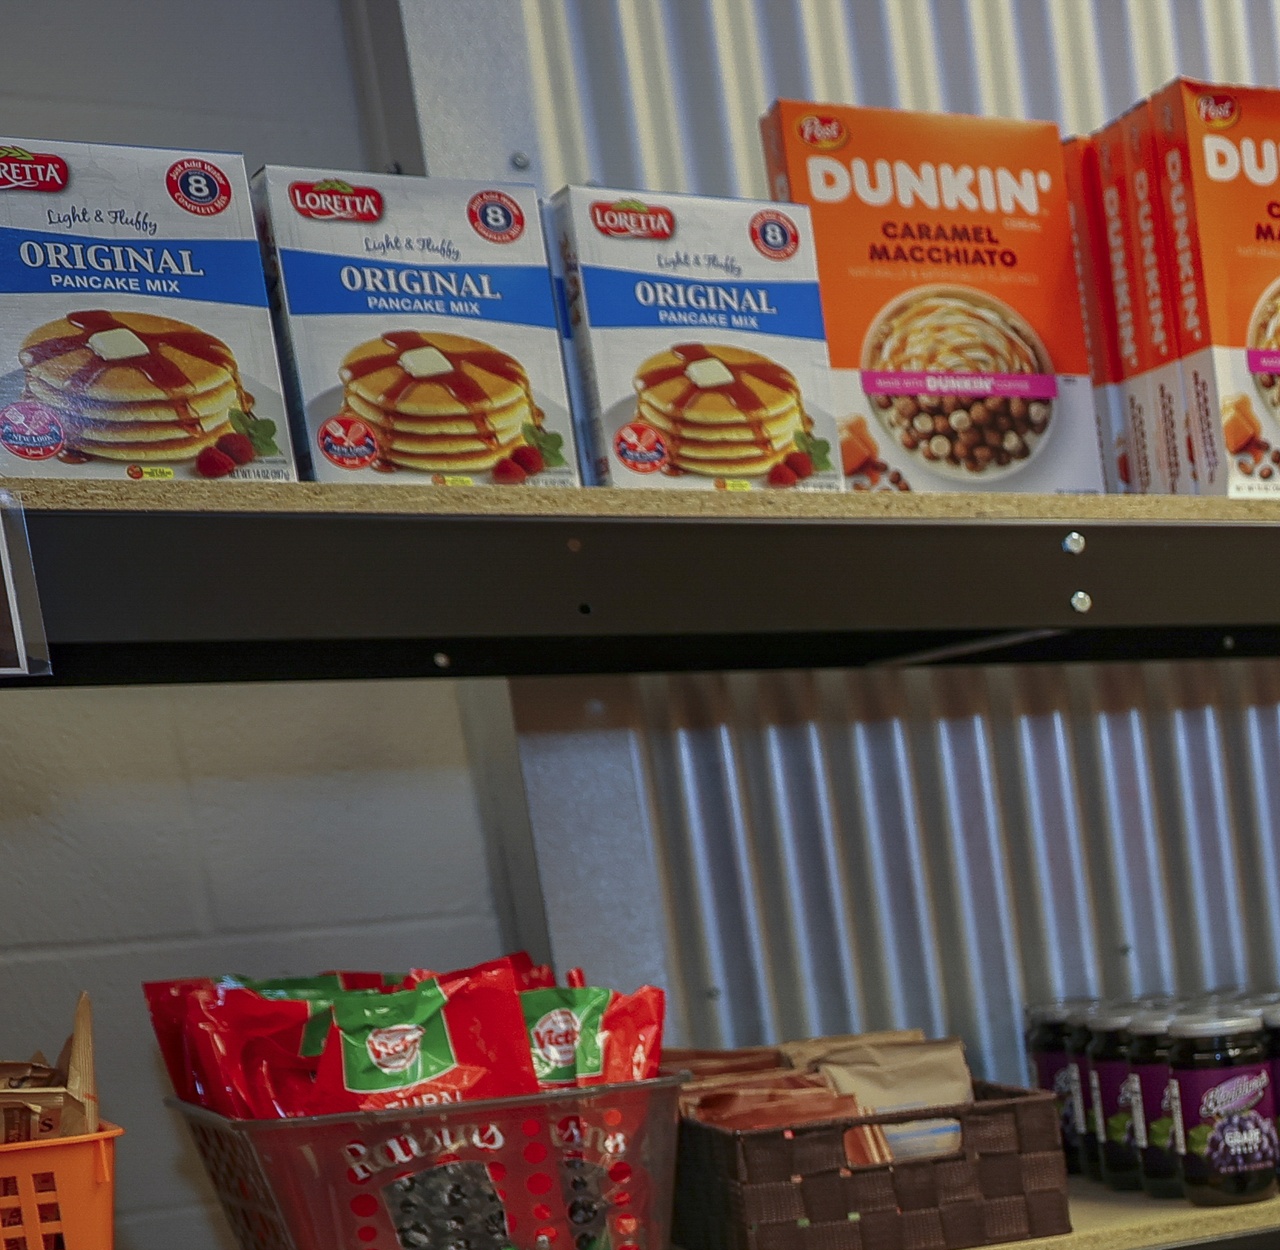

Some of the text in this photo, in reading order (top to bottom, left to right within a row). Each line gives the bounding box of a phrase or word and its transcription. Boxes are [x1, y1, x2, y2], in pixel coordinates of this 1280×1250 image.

[801, 116, 839, 141] Post
[188, 174, 210, 198] 8
[806, 155, 1051, 216] DUNKIN'
[294, 189, 377, 218] LORETTA
[47, 204, 157, 236] Light & Fluffy
[486, 205, 505, 227] 8
[594, 210, 670, 236] LORETTA
[364, 234, 401, 256] Light
[765, 224, 782, 243] 8
[882, 221, 999, 245] CARAMEL
[19, 240, 204, 277] ORIGINAL
[869, 245, 1018, 268] MACCHIATO
[51, 273, 181, 294] PANCAKE MIX
[340, 265, 501, 299] ORIGINAL
[367, 296, 481, 316] PANCAKE MIX
[634, 281, 777, 315] ORIGINAL
[658, 310, 759, 330] PANCAKE MIX
